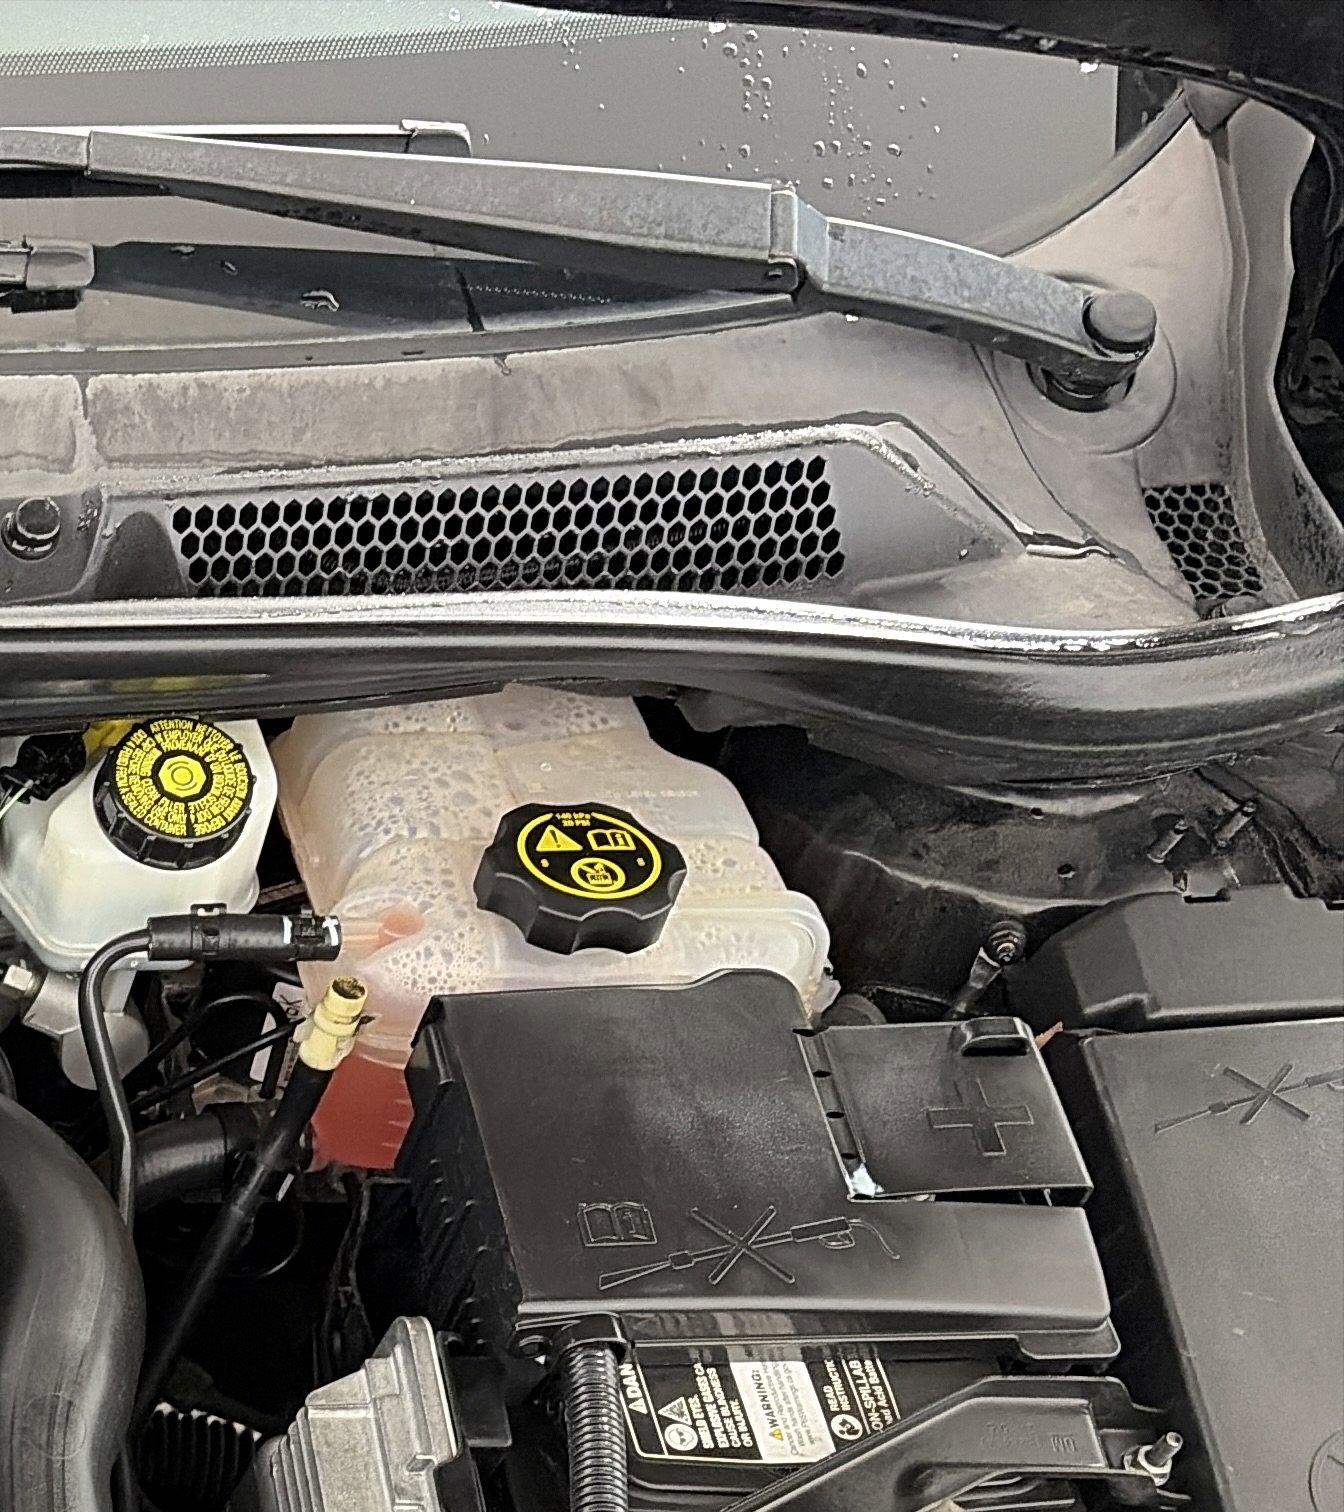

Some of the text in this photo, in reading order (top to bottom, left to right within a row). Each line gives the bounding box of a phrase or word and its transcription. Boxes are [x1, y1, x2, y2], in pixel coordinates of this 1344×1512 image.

[150, 719, 193, 733] ATTENTION
[752, 1370, 779, 1428] WARNING:
[823, 1386, 840, 1411] READ
[849, 1360, 884, 1432] ON-SPILLAB
[872, 1386, 888, 1407] Acid
[724, 1417, 741, 1447] CAUSE
[741, 1433, 753, 1447] OR
